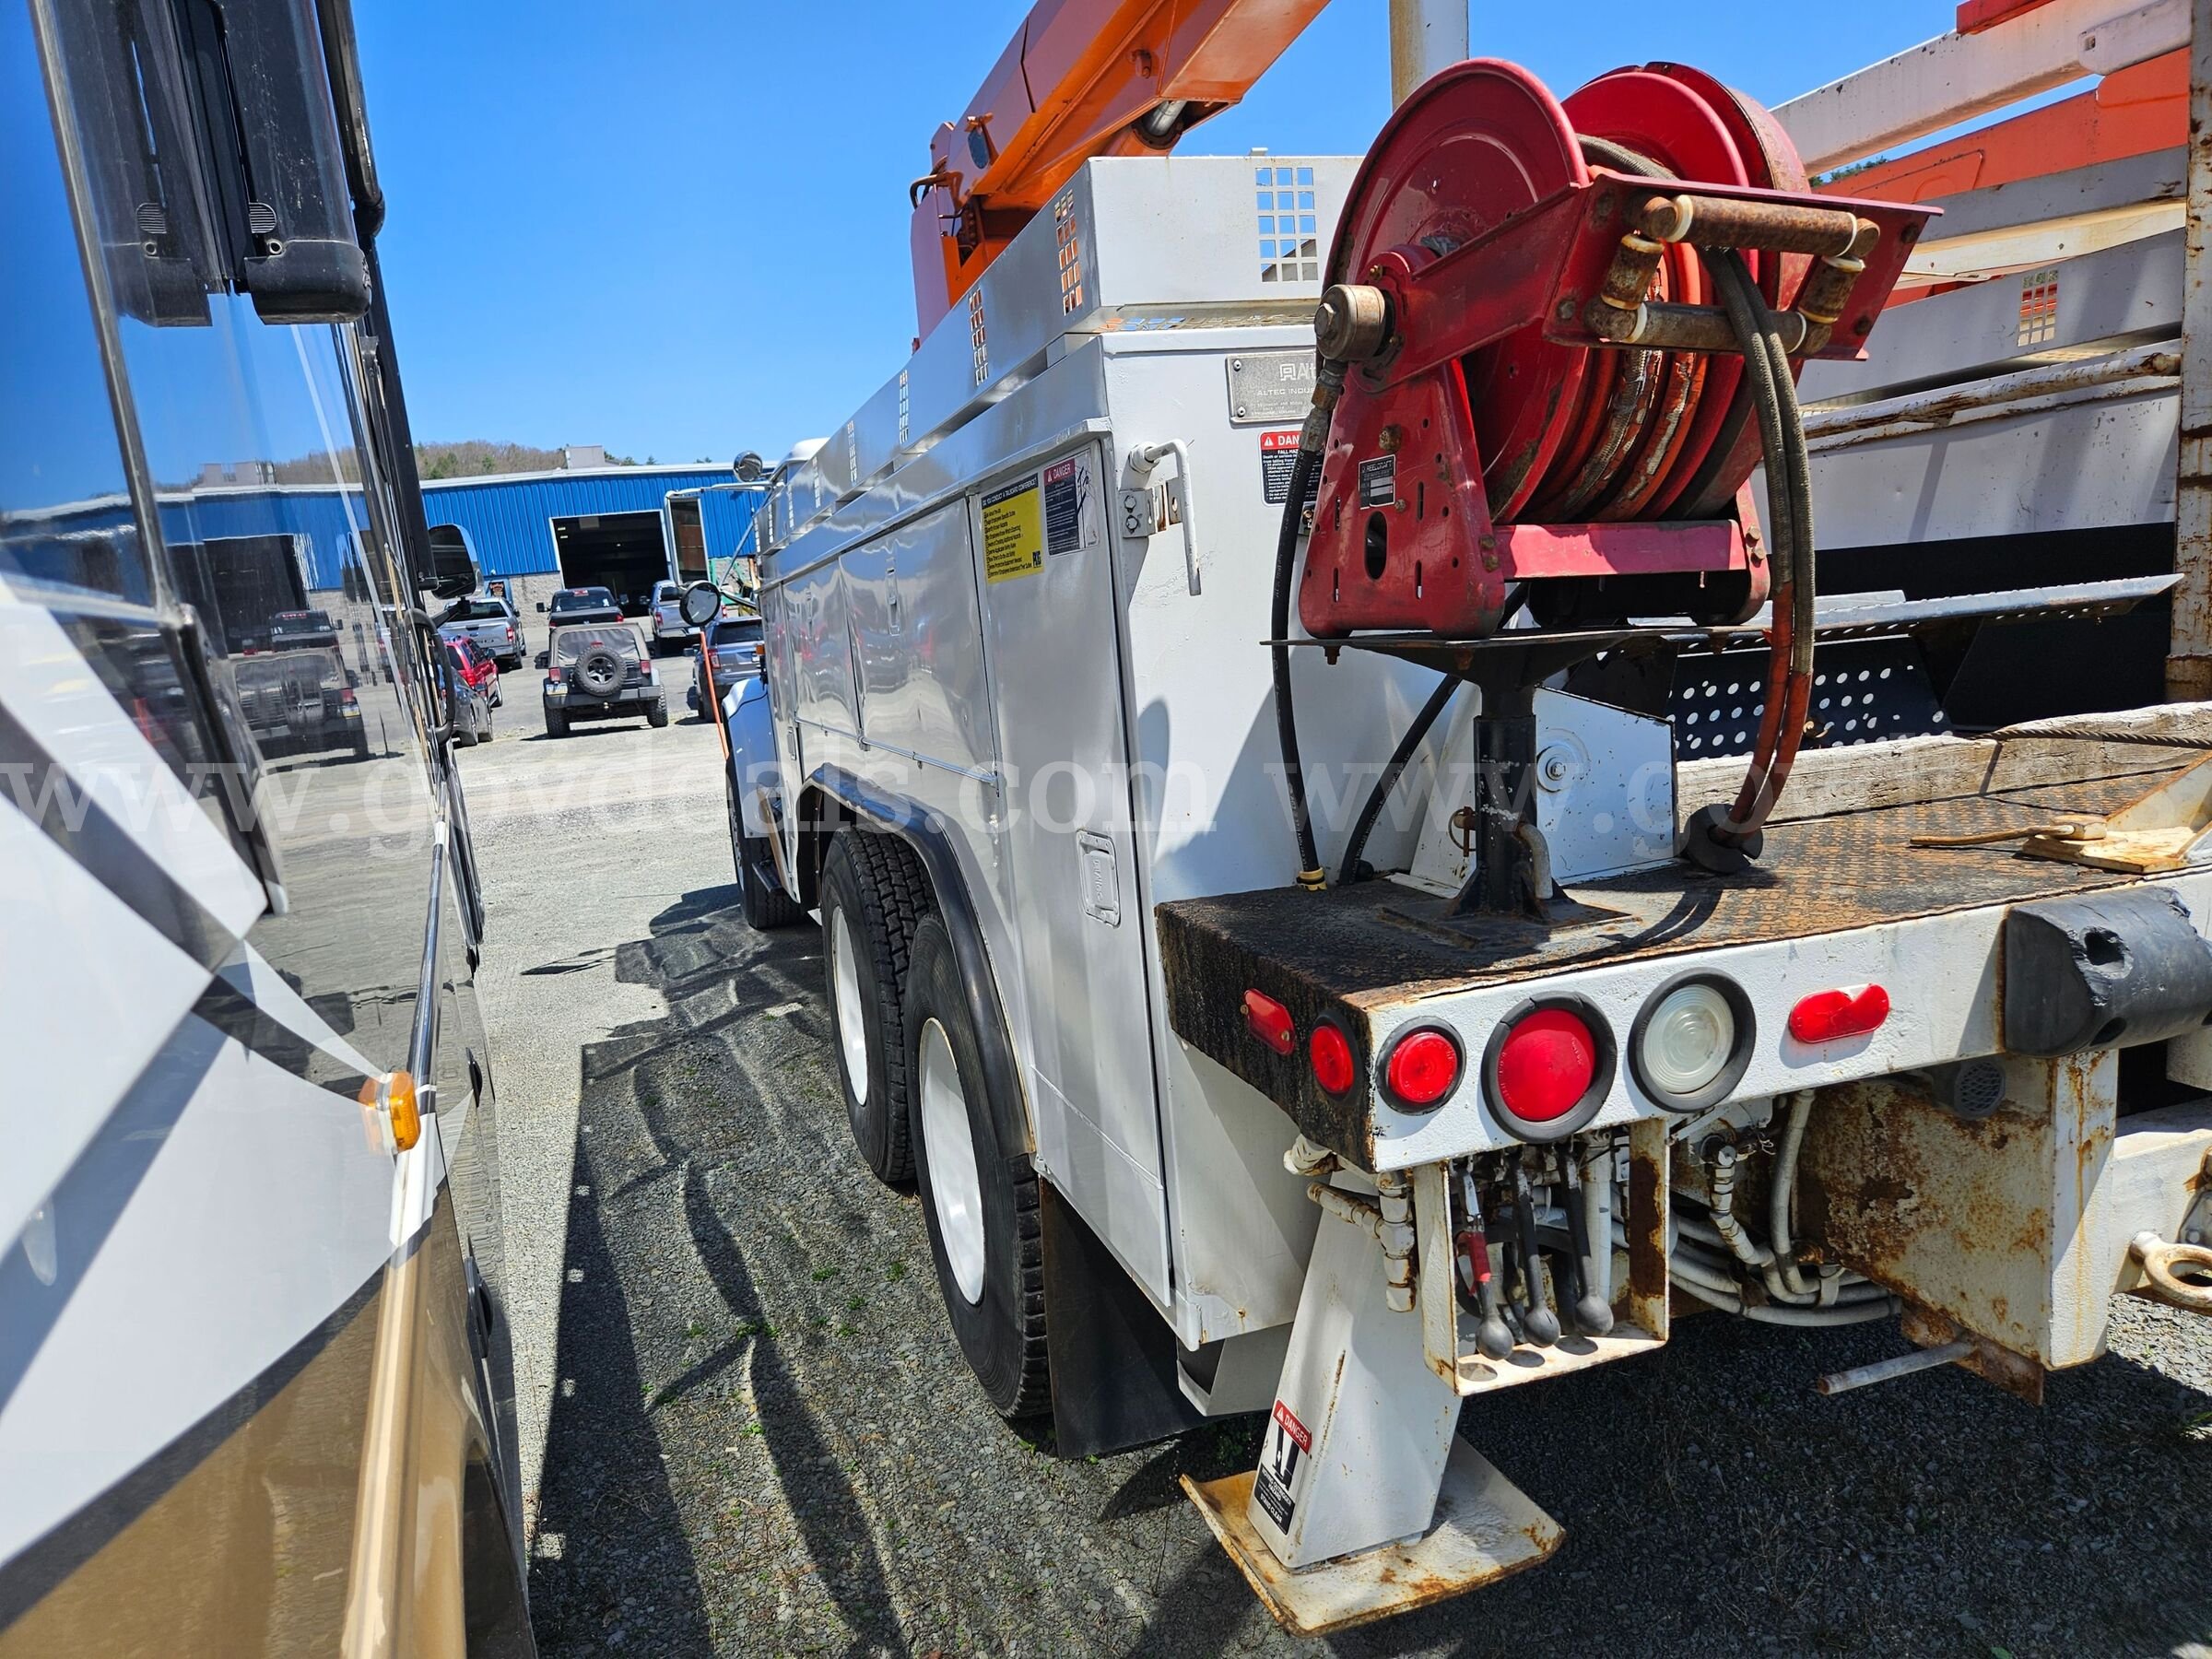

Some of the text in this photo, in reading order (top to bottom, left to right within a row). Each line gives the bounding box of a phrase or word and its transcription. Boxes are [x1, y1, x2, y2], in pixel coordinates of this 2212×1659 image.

[1053, 463, 1071, 479] DANGER
[1284, 1414, 1308, 1447] DANGER
[1271, 1506, 1282, 1524] CLEAR
